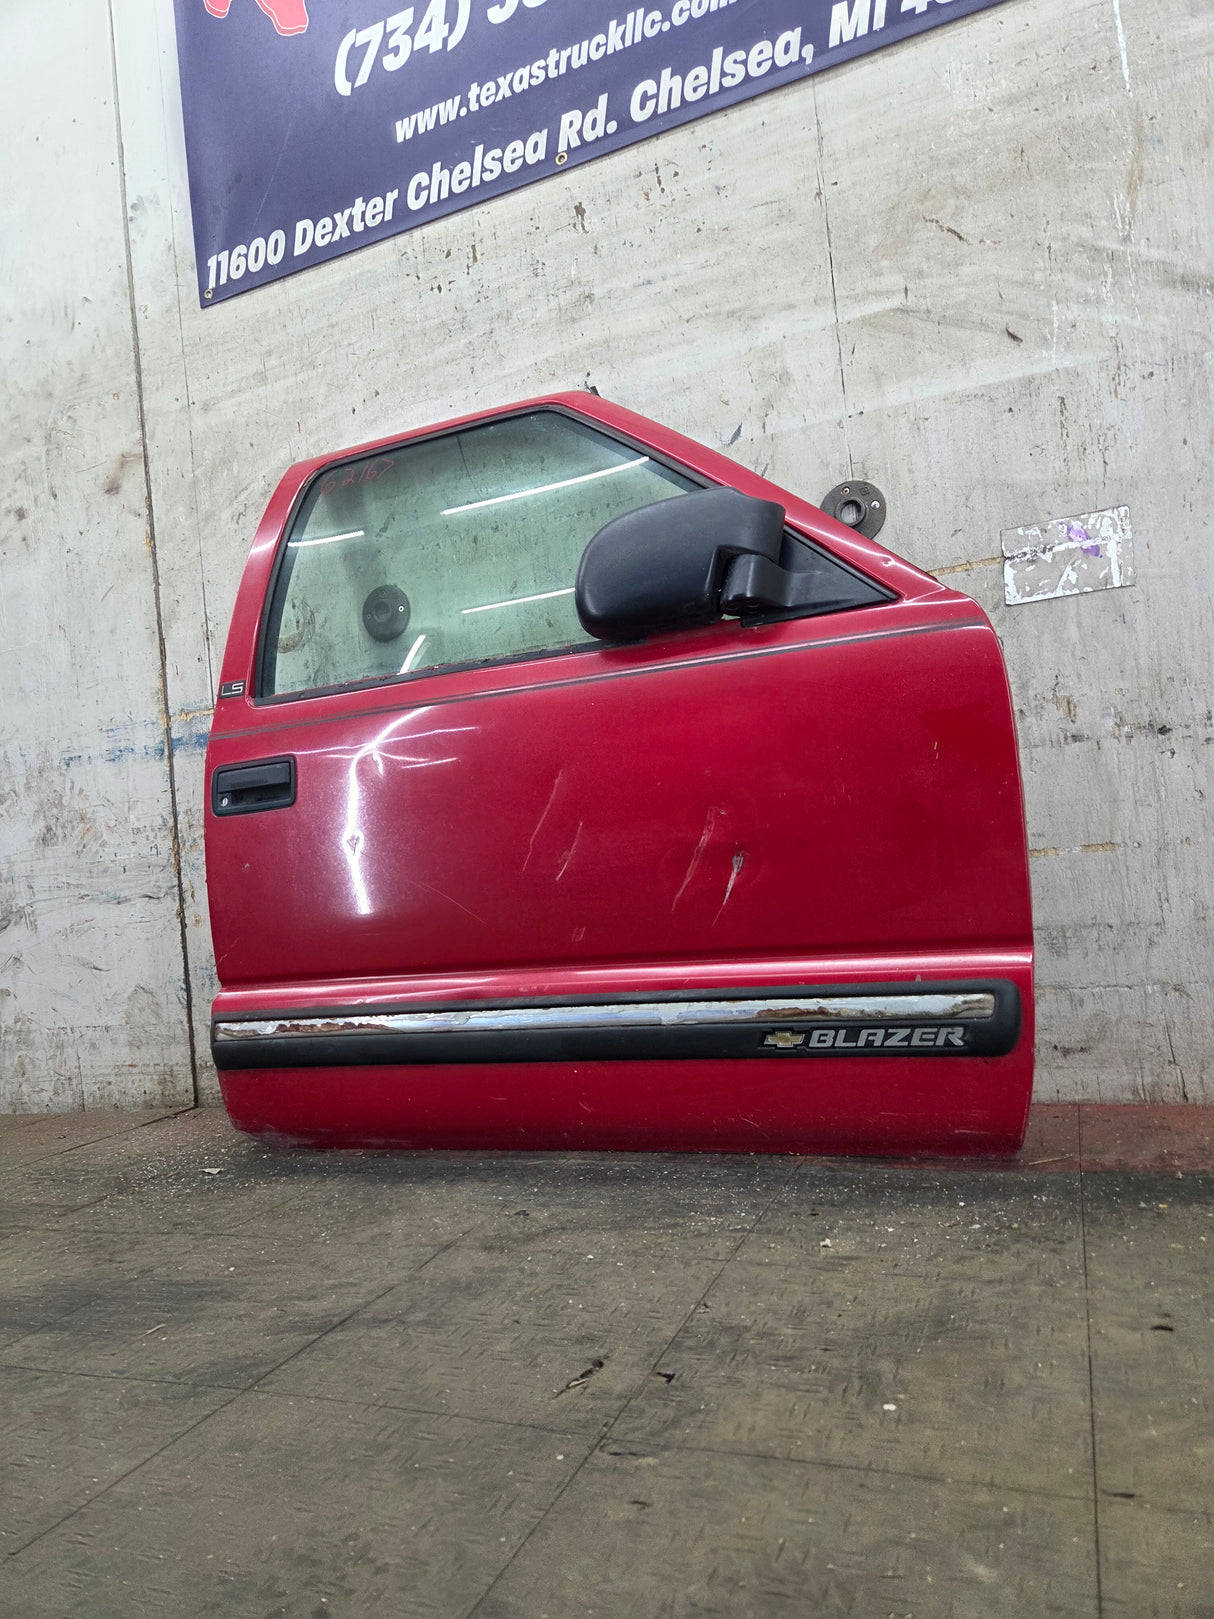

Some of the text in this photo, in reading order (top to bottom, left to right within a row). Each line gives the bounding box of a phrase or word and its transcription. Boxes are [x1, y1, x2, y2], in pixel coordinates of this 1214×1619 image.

[335, 0, 471, 96] (734)
[207, 0, 887, 289] 11600 Dexter Chelsea Rd. Chelsea, MI
[221, 682, 245, 696] LS
[808, 1027, 964, 1048] BLAZER
